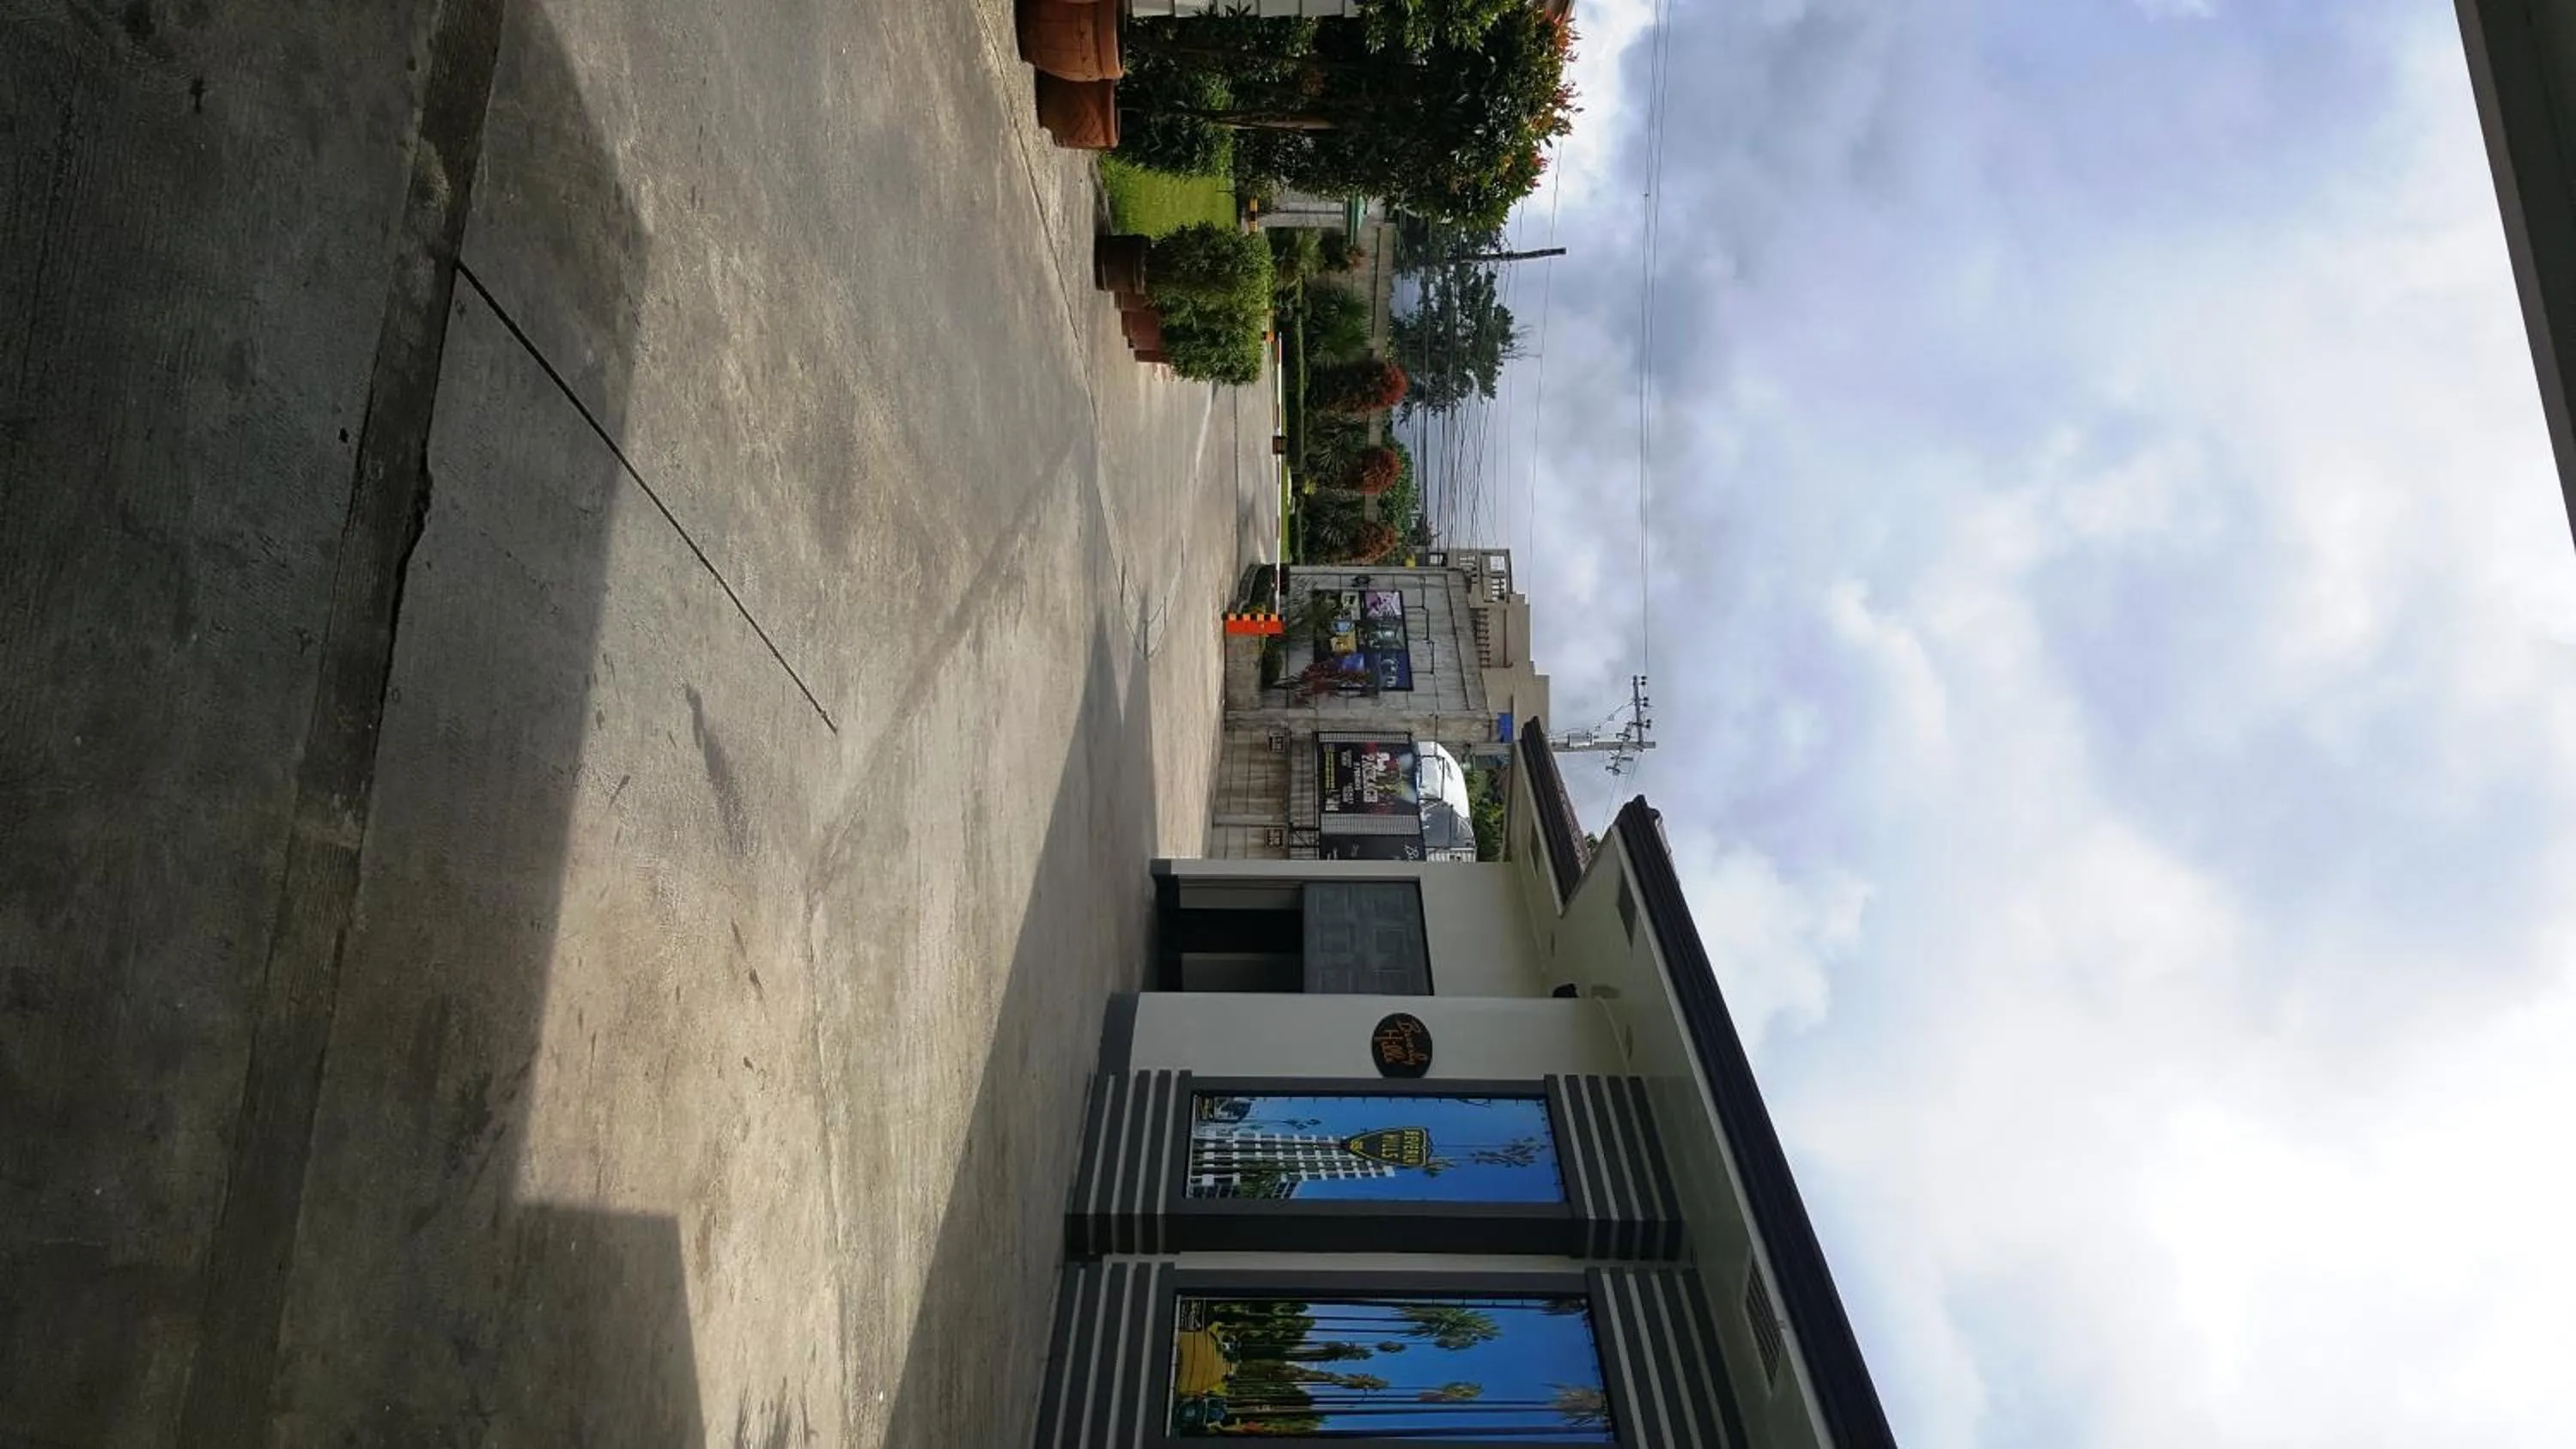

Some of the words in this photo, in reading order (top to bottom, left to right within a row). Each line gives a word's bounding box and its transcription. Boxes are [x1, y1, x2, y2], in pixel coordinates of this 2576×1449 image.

[1374, 1030, 1407, 1063] Hills
[1382, 1134, 1400, 1158] HILLS
[1404, 1131, 1420, 1164] BEVERLY
